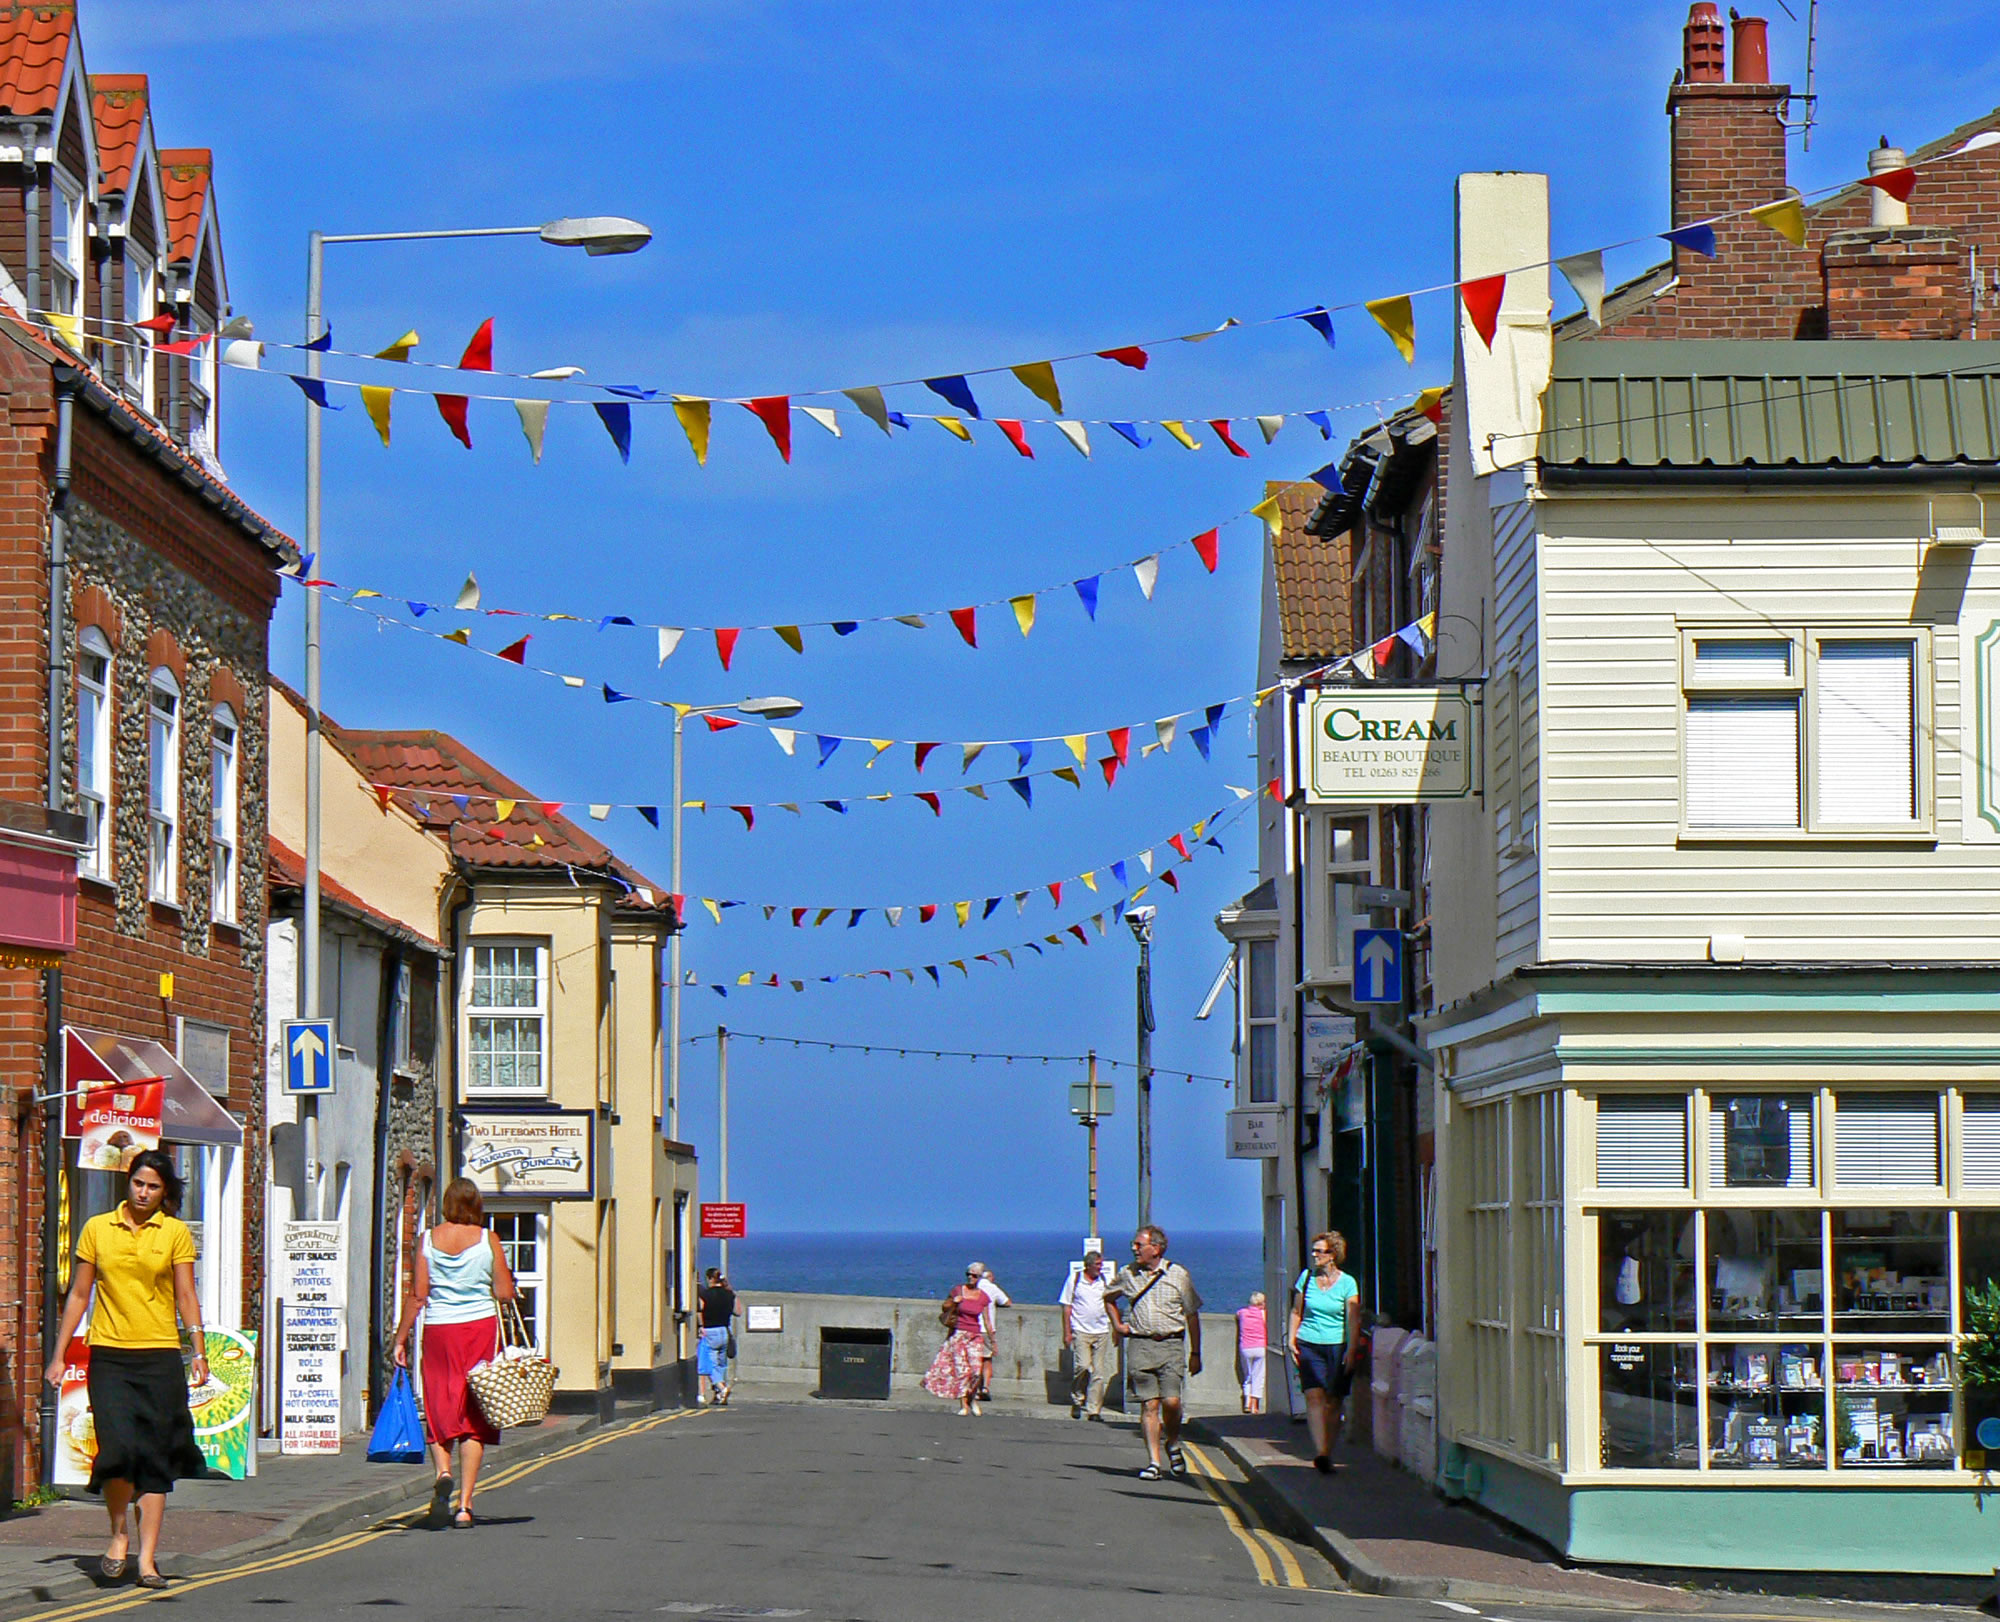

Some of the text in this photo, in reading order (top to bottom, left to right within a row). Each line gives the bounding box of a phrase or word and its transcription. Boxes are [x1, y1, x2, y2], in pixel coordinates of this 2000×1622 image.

[1323, 707, 1457, 741] CREAM
[1322, 750, 1461, 763] BEAUTY BOUTIQUE
[1343, 768, 1366, 777] TEL
[1370, 767, 1398, 777] 01263
[1402, 767, 1418, 777] 825
[90, 1109, 155, 1128] delicious
[492, 1125, 547, 1137] LIFEBOATS
[549, 1125, 583, 1137] HOTEL
[479, 1148, 525, 1167] AUGUSTA
[520, 1158, 571, 1170] DUNCAN
[297, 1241, 322, 1249] CAFE
[289, 1252, 337, 1261] HOT SNACKS
[296, 1268, 325, 1276] JACKET
[292, 1278, 332, 1286] POTATOES
[297, 1293, 327, 1301] SALADS
[296, 1308, 333, 1317] TOASTED
[286, 1318, 338, 1327] SANDWICHES
[286, 1333, 336, 1342] FRESHLY CUT
[287, 1343, 336, 1352] SANDWICHES
[298, 1358, 323, 1367] ROLLS
[296, 1374, 323, 1383] CAKES
[285, 1399, 339, 1408] HOT CHOCOLATE
[285, 1415, 336, 1423] MILK SHAKES
[285, 1430, 337, 1439] ALL AVAILABLE
[285, 1440, 299, 1448] FOR
